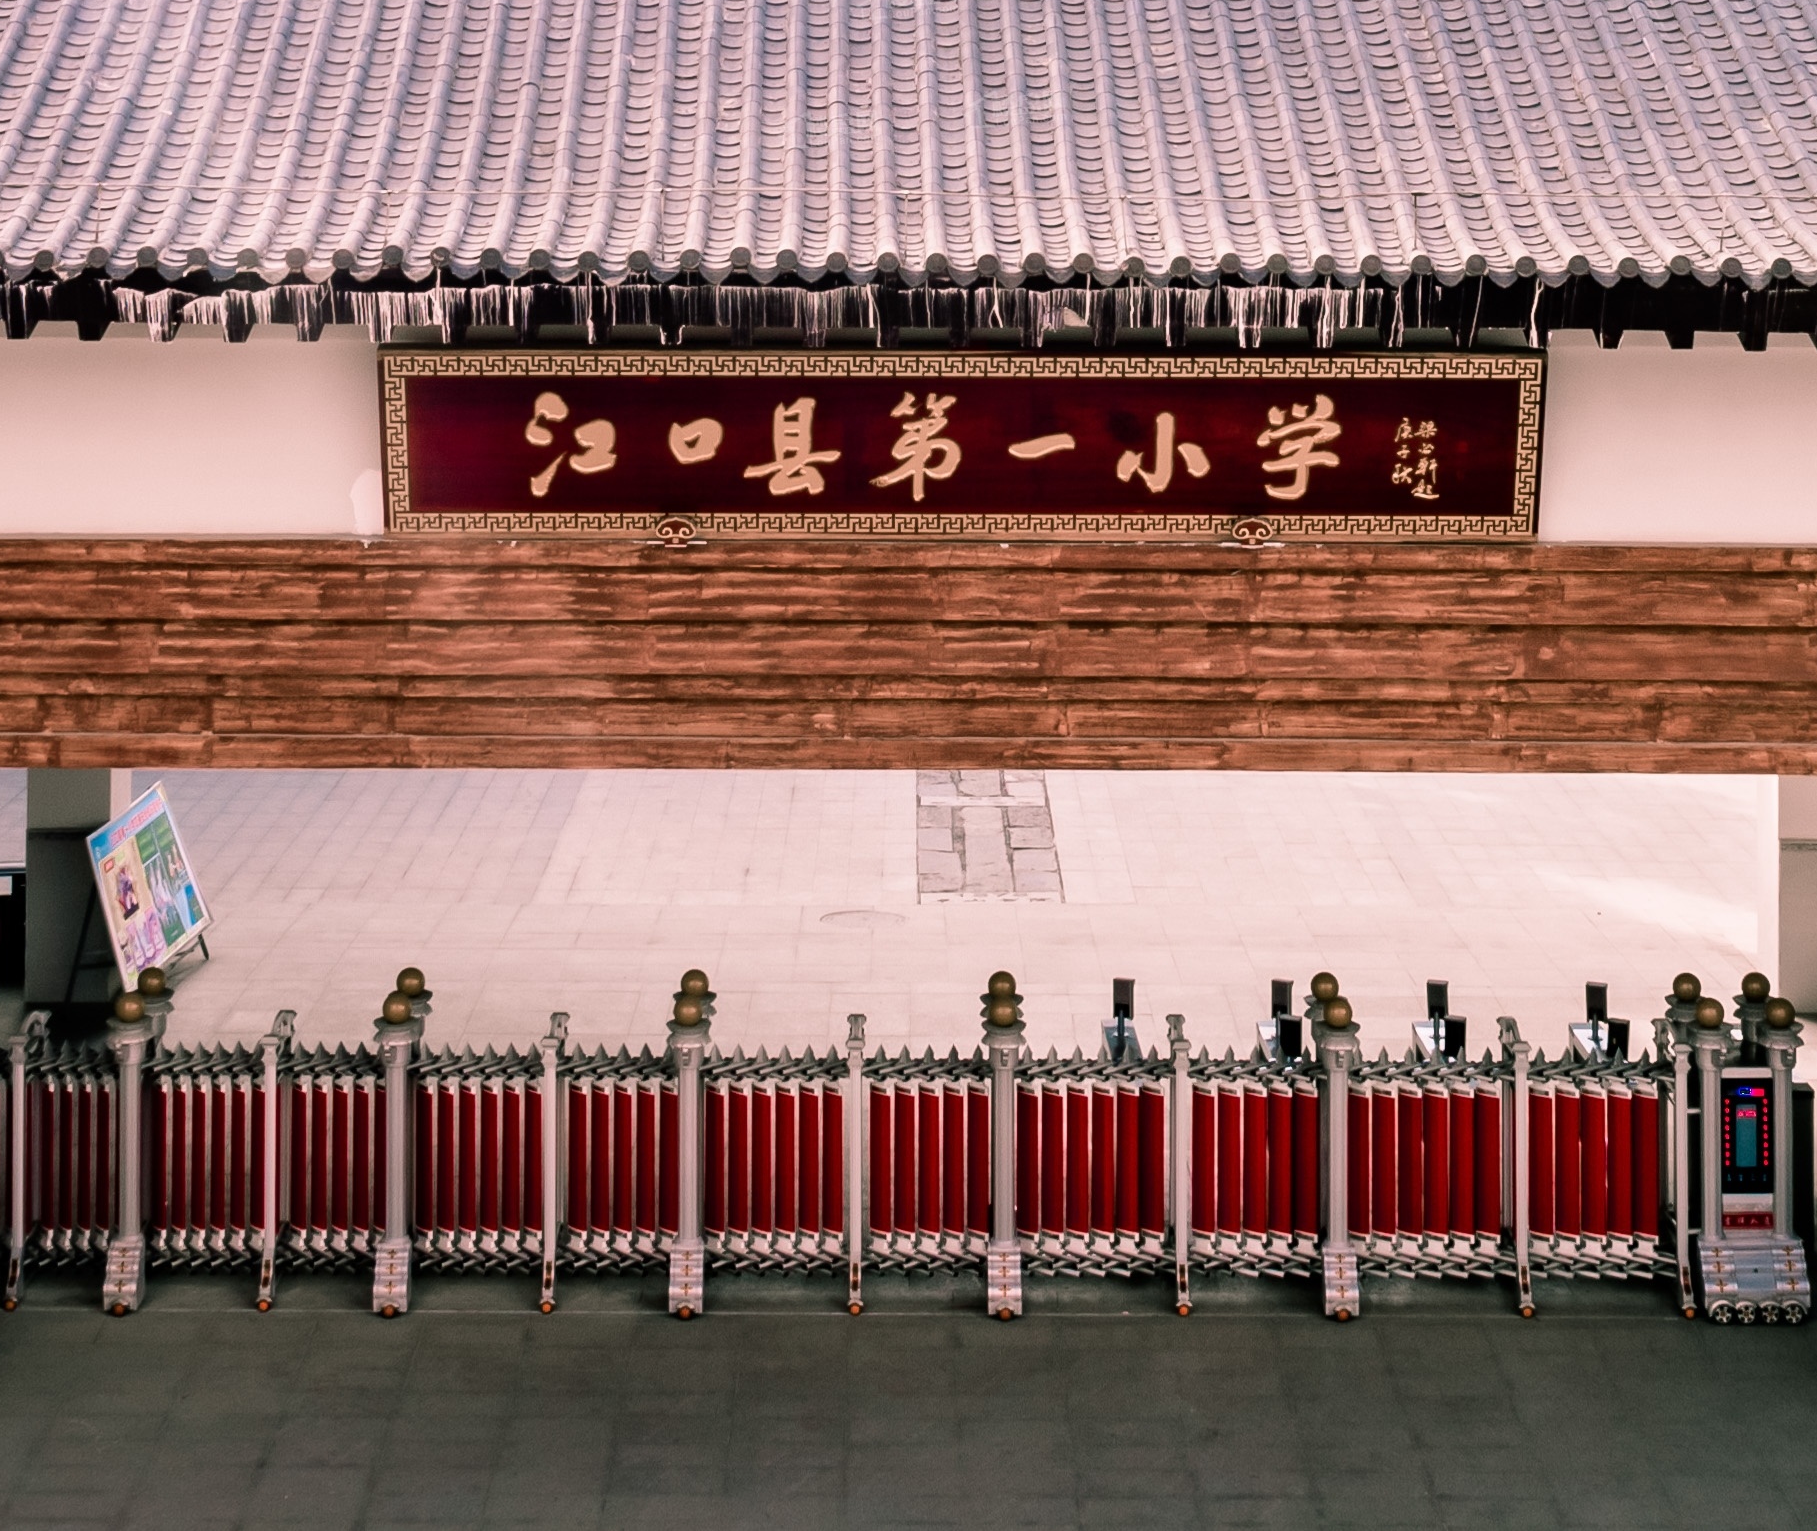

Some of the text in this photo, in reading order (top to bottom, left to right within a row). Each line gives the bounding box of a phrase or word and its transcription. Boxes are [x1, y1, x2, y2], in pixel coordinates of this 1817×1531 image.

[524, 391, 1342, 503] 江口县第一小学
